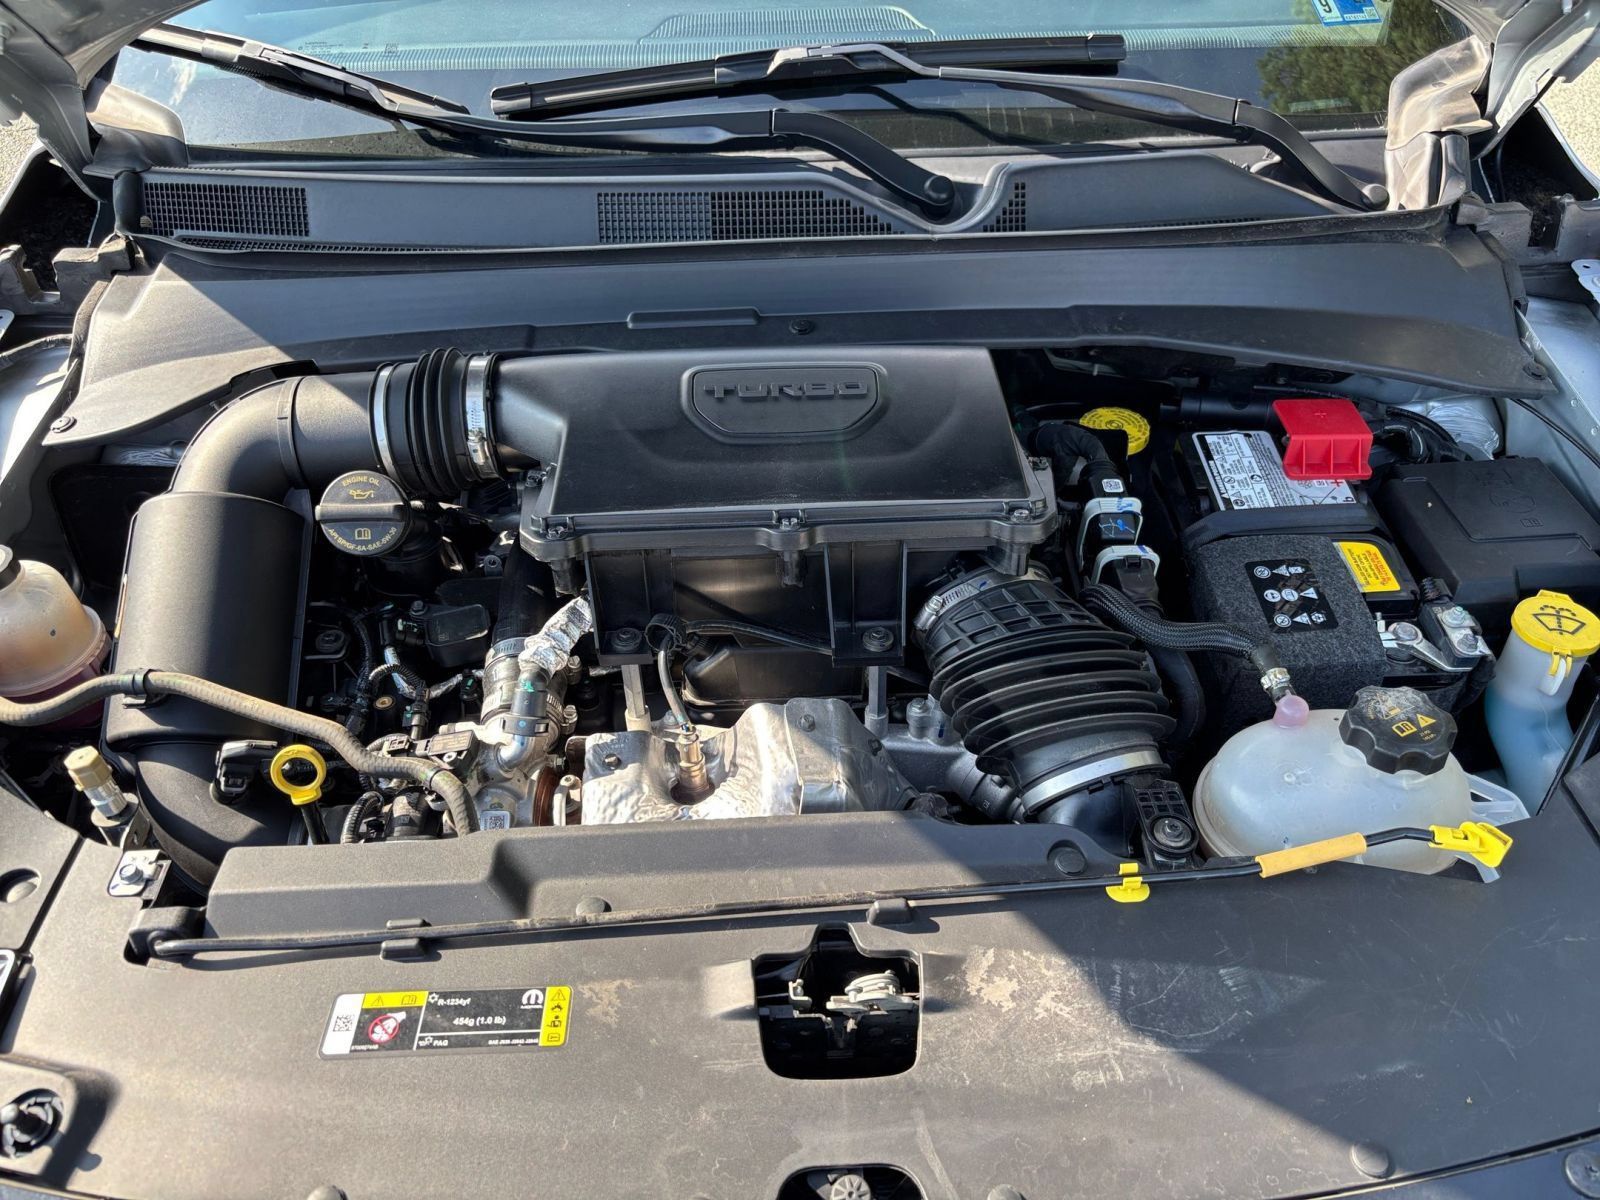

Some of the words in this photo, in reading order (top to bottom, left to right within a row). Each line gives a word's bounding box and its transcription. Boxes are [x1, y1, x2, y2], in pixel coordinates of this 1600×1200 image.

[703, 382, 868, 399] TURBO
[342, 476, 368, 487] ENGINE
[368, 477, 380, 487] OIL
[328, 528, 339, 540] API
[437, 997, 471, 1007] R-1234yf
[452, 1016, 475, 1027] 454g
[476, 1016, 493, 1027] (1.0
[494, 1015, 507, 1026] lb)
[433, 1039, 448, 1047] PAG
